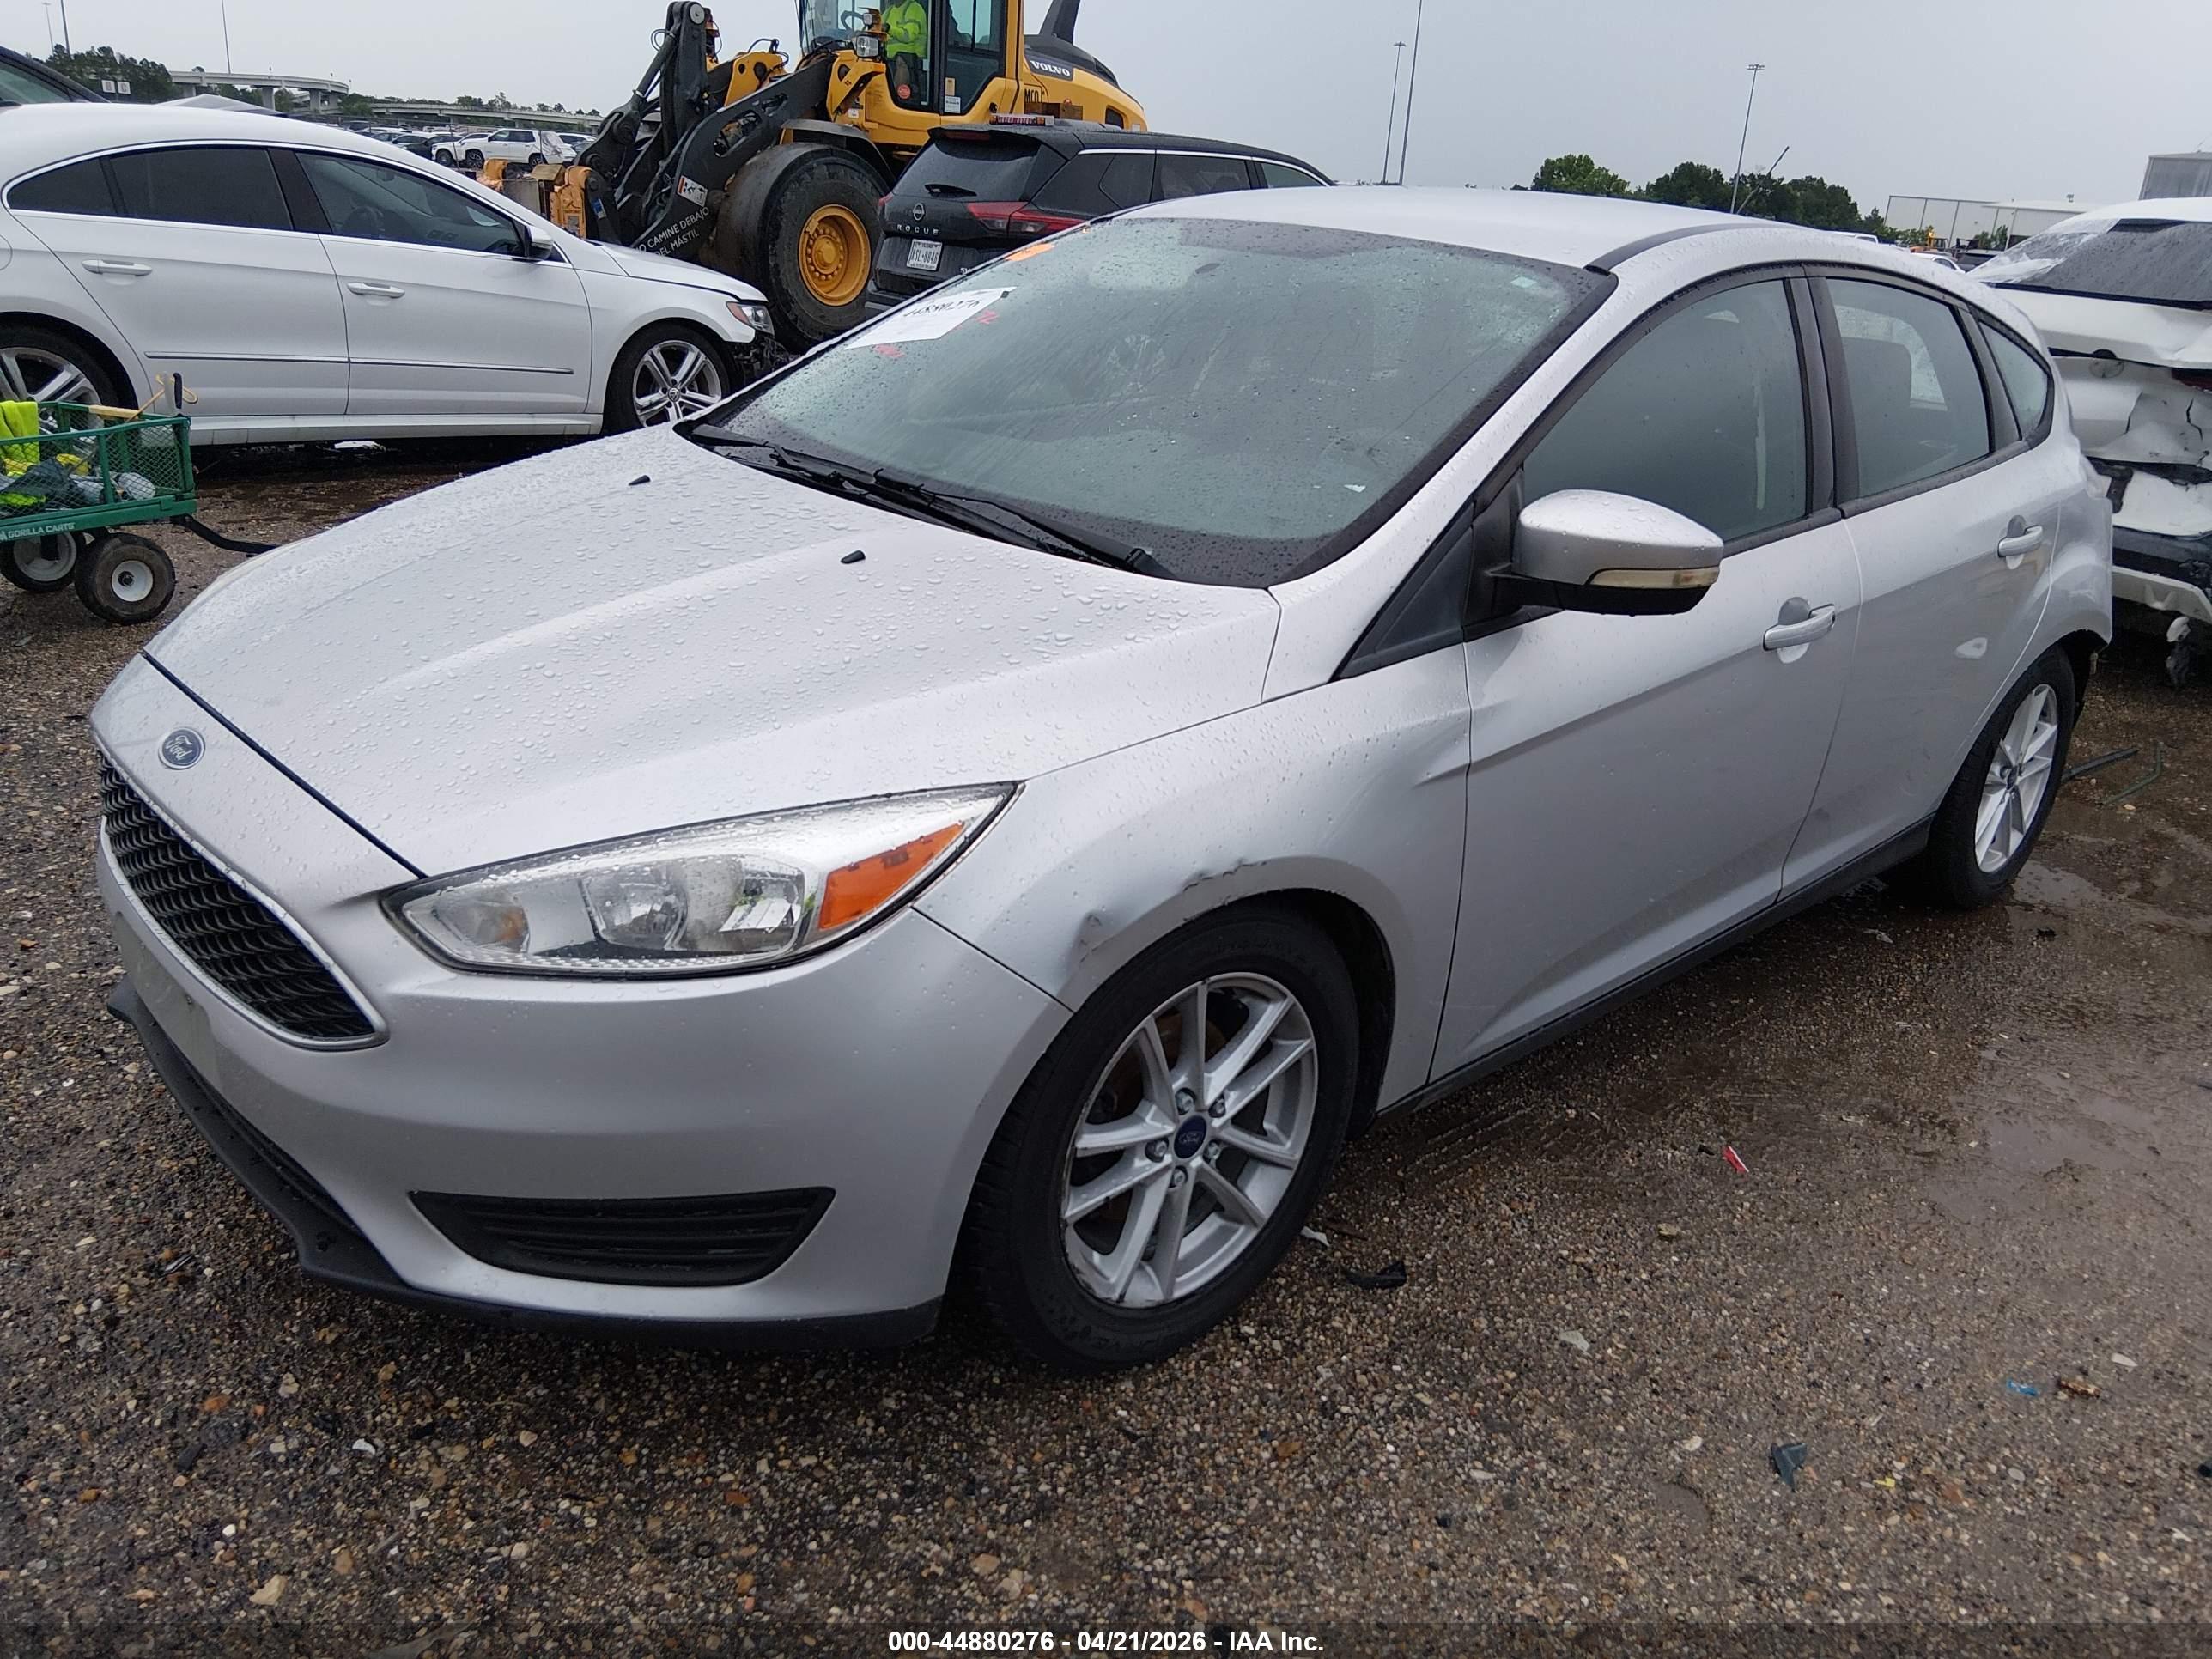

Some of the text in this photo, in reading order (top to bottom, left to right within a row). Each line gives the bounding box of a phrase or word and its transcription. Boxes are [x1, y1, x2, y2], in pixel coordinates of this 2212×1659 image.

[1030, 60, 1071, 76] VOLVO
[647, 223, 680, 248] CAMINE
[679, 207, 709, 229] DEBAJO
[897, 224, 939, 235] ROGUE
[8, 522, 76, 538] GORILLA CARTS
